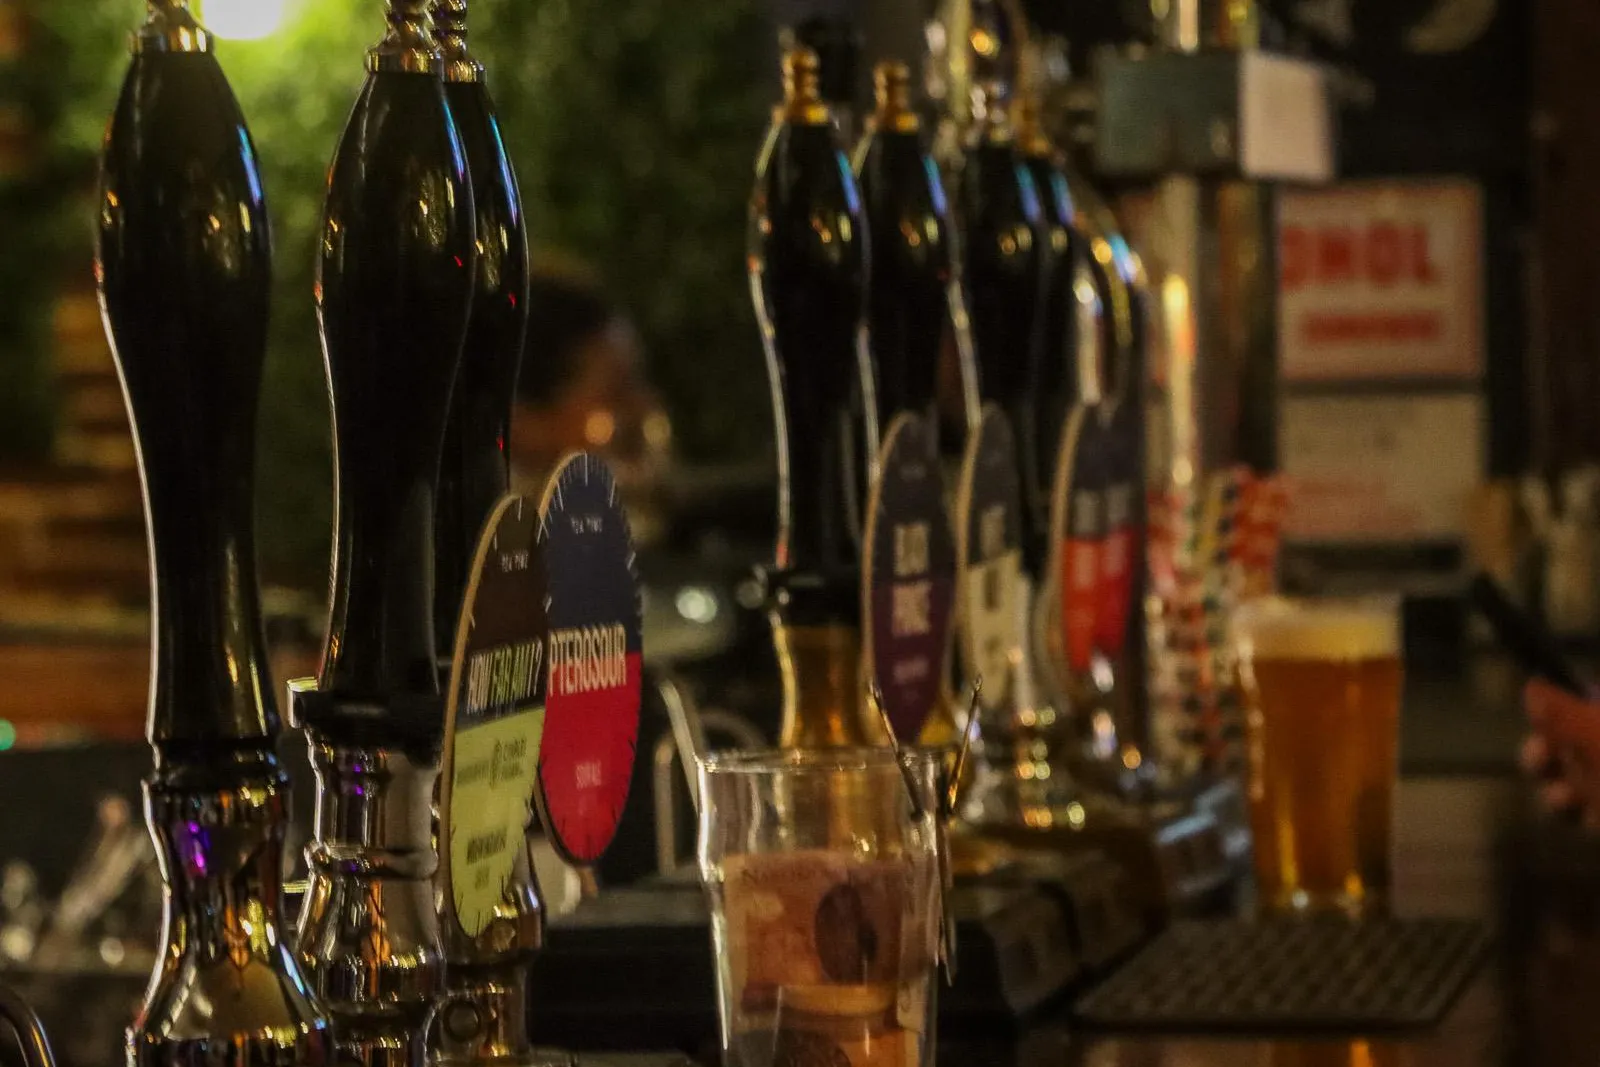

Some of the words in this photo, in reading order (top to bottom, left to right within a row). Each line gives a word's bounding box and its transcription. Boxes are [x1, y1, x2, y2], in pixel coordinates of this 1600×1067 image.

[466, 652, 493, 715] HOW
[490, 645, 513, 708] FAR
[548, 623, 627, 698] PTEROSOUR
